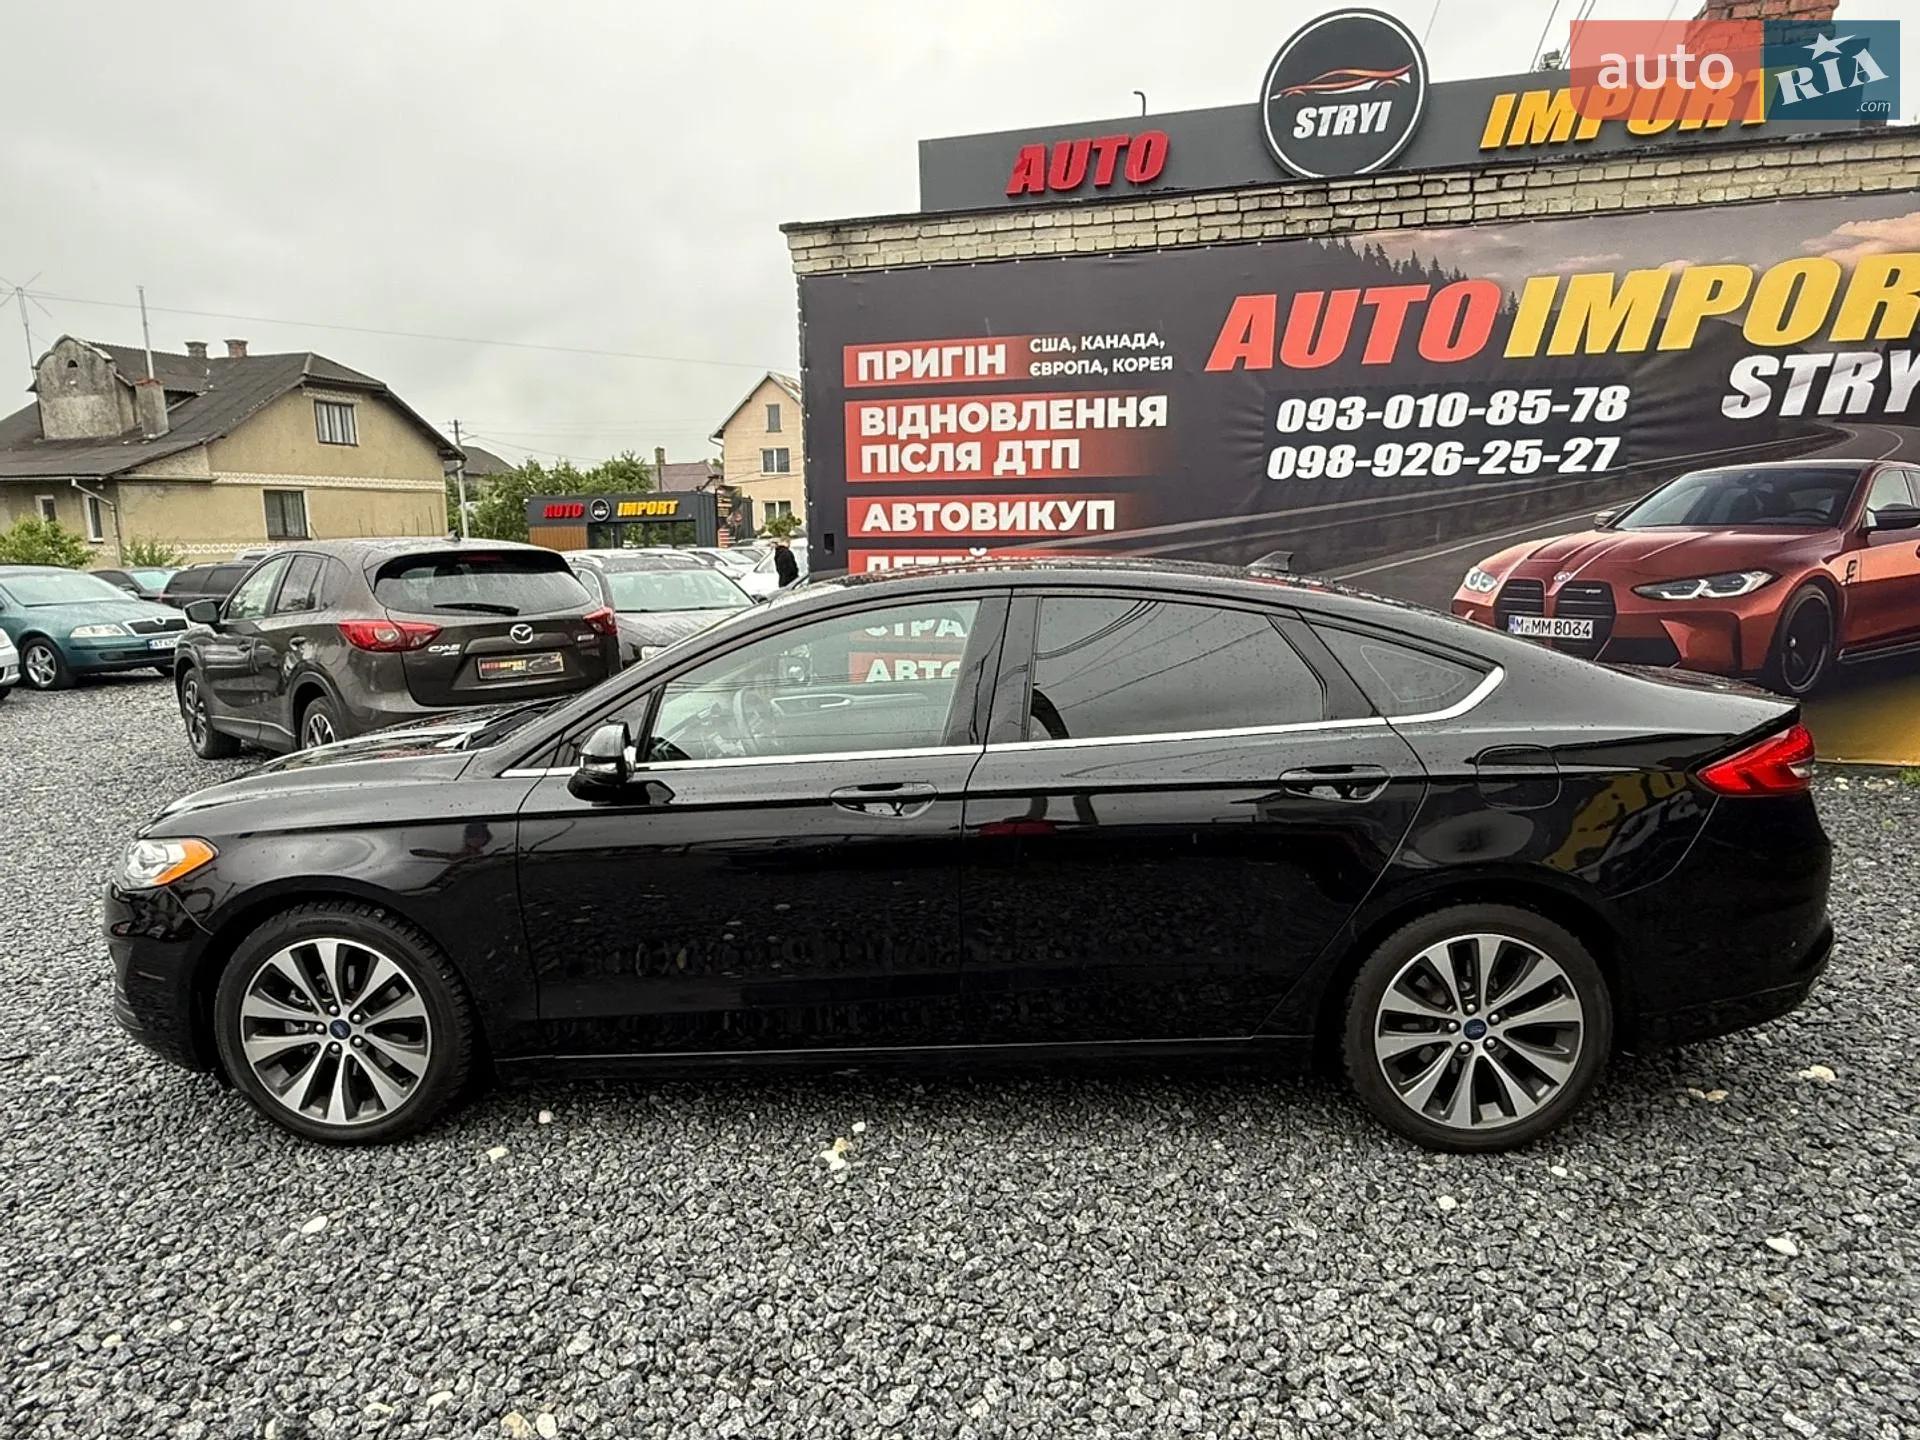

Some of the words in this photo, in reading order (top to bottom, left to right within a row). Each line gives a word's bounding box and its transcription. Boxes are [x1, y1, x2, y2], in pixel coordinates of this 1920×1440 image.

[1005, 130, 1171, 196] AUTO
[1479, 65, 1799, 151] IMPORT
[1292, 100, 1393, 140] STRYI
[1029, 337, 1077, 354] США,
[1081, 331, 1166, 351] КАНАДА,
[1204, 277, 1502, 372] AUTO
[857, 344, 1007, 381] ПРИГІН
[1029, 359, 1109, 377] ЄВРОПА,
[1112, 355, 1174, 374] КОРЕЯ
[860, 395, 1168, 440] ВІДНОВЛЕННЯ
[1275, 385, 1631, 434] 093-010-85-78
[860, 441, 982, 474] ПІСЛЯ
[993, 438, 1081, 477] ДТП
[1266, 437, 1622, 480] 098-926-25-27
[543, 502, 584, 519] AUTO
[617, 500, 679, 517] IMPORT
[862, 500, 1116, 533] АВТОВИКУП
